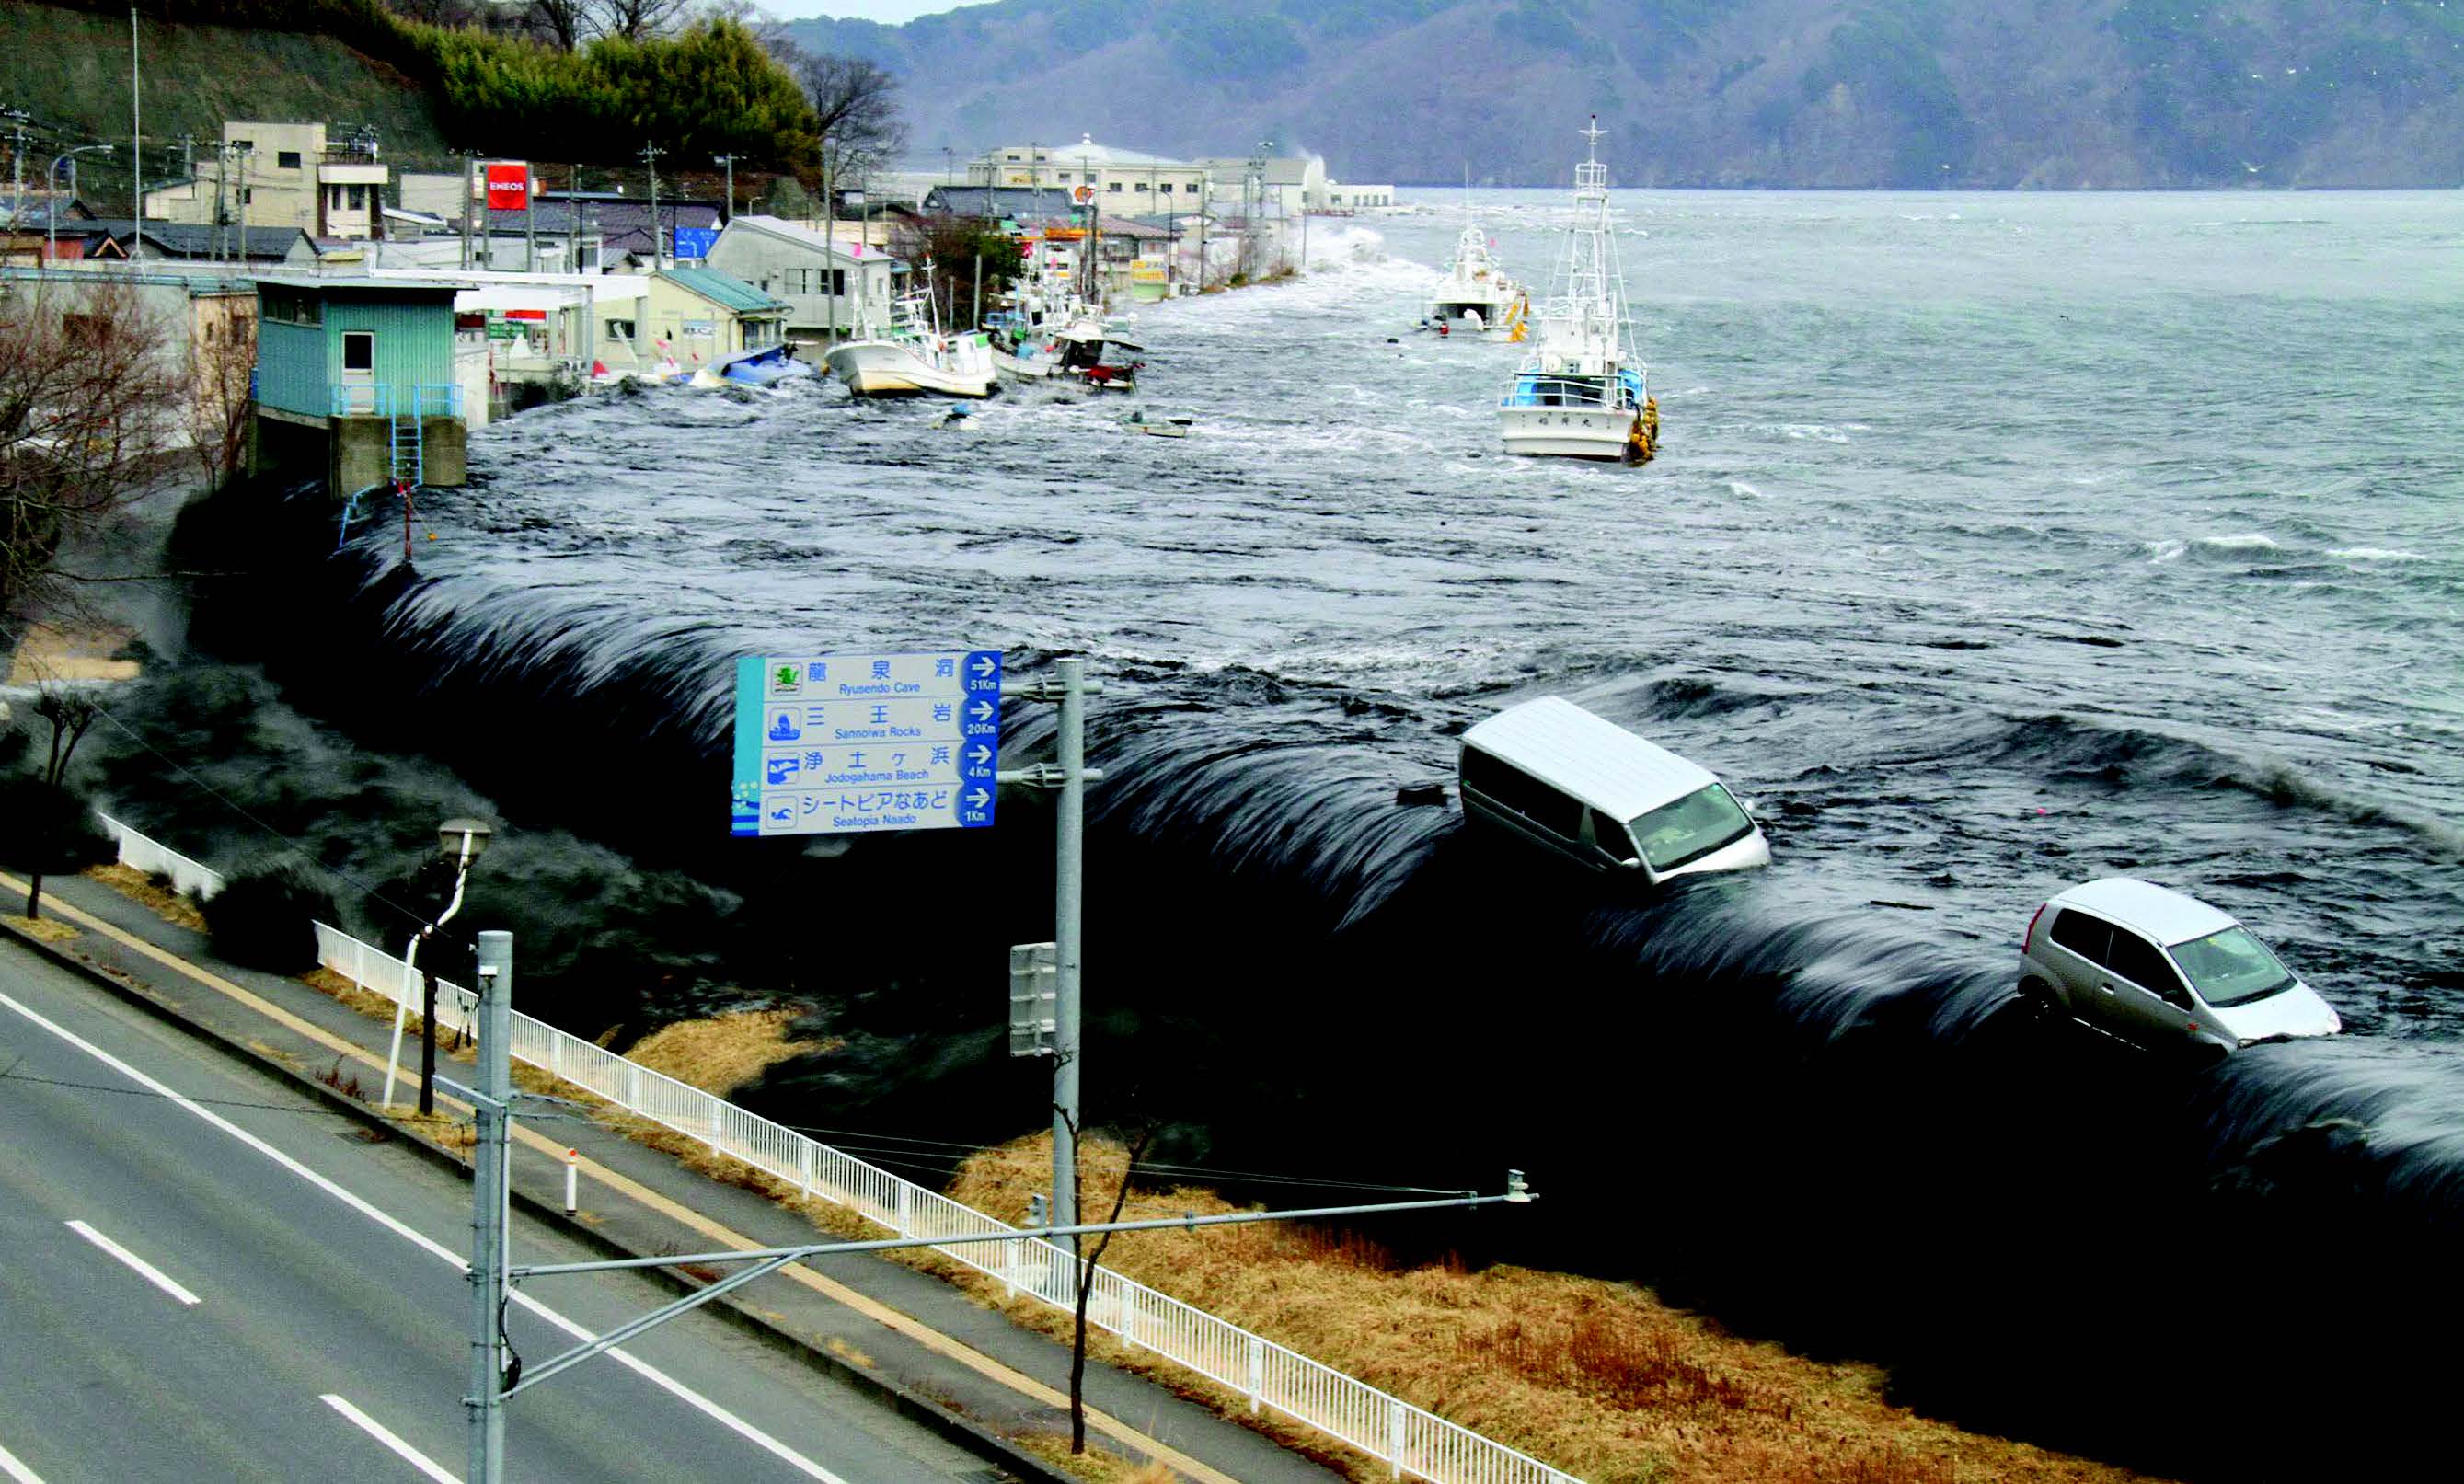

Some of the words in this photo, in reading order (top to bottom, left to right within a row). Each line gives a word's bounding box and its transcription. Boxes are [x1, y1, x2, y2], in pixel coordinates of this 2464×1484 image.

[489, 181, 524, 191] ENEOS
[809, 658, 954, 682] 龍泉洞
[839, 683, 890, 696] Ryusendo
[894, 682, 920, 693] Cave
[970, 679, 996, 690] 51Km
[807, 703, 951, 725] 三王岩
[835, 728, 886, 740] Sannoiwa
[890, 726, 921, 738] Rocks
[967, 723, 996, 735] 20Km
[824, 772, 892, 784] Jodogahama
[896, 769, 929, 781] Beach
[968, 765, 991, 777] 4Km
[802, 791, 947, 814] シートピアなあど
[833, 816, 879, 829] Seatopia
[882, 814, 916, 825] Naado
[965, 810, 986, 822] 1Km
